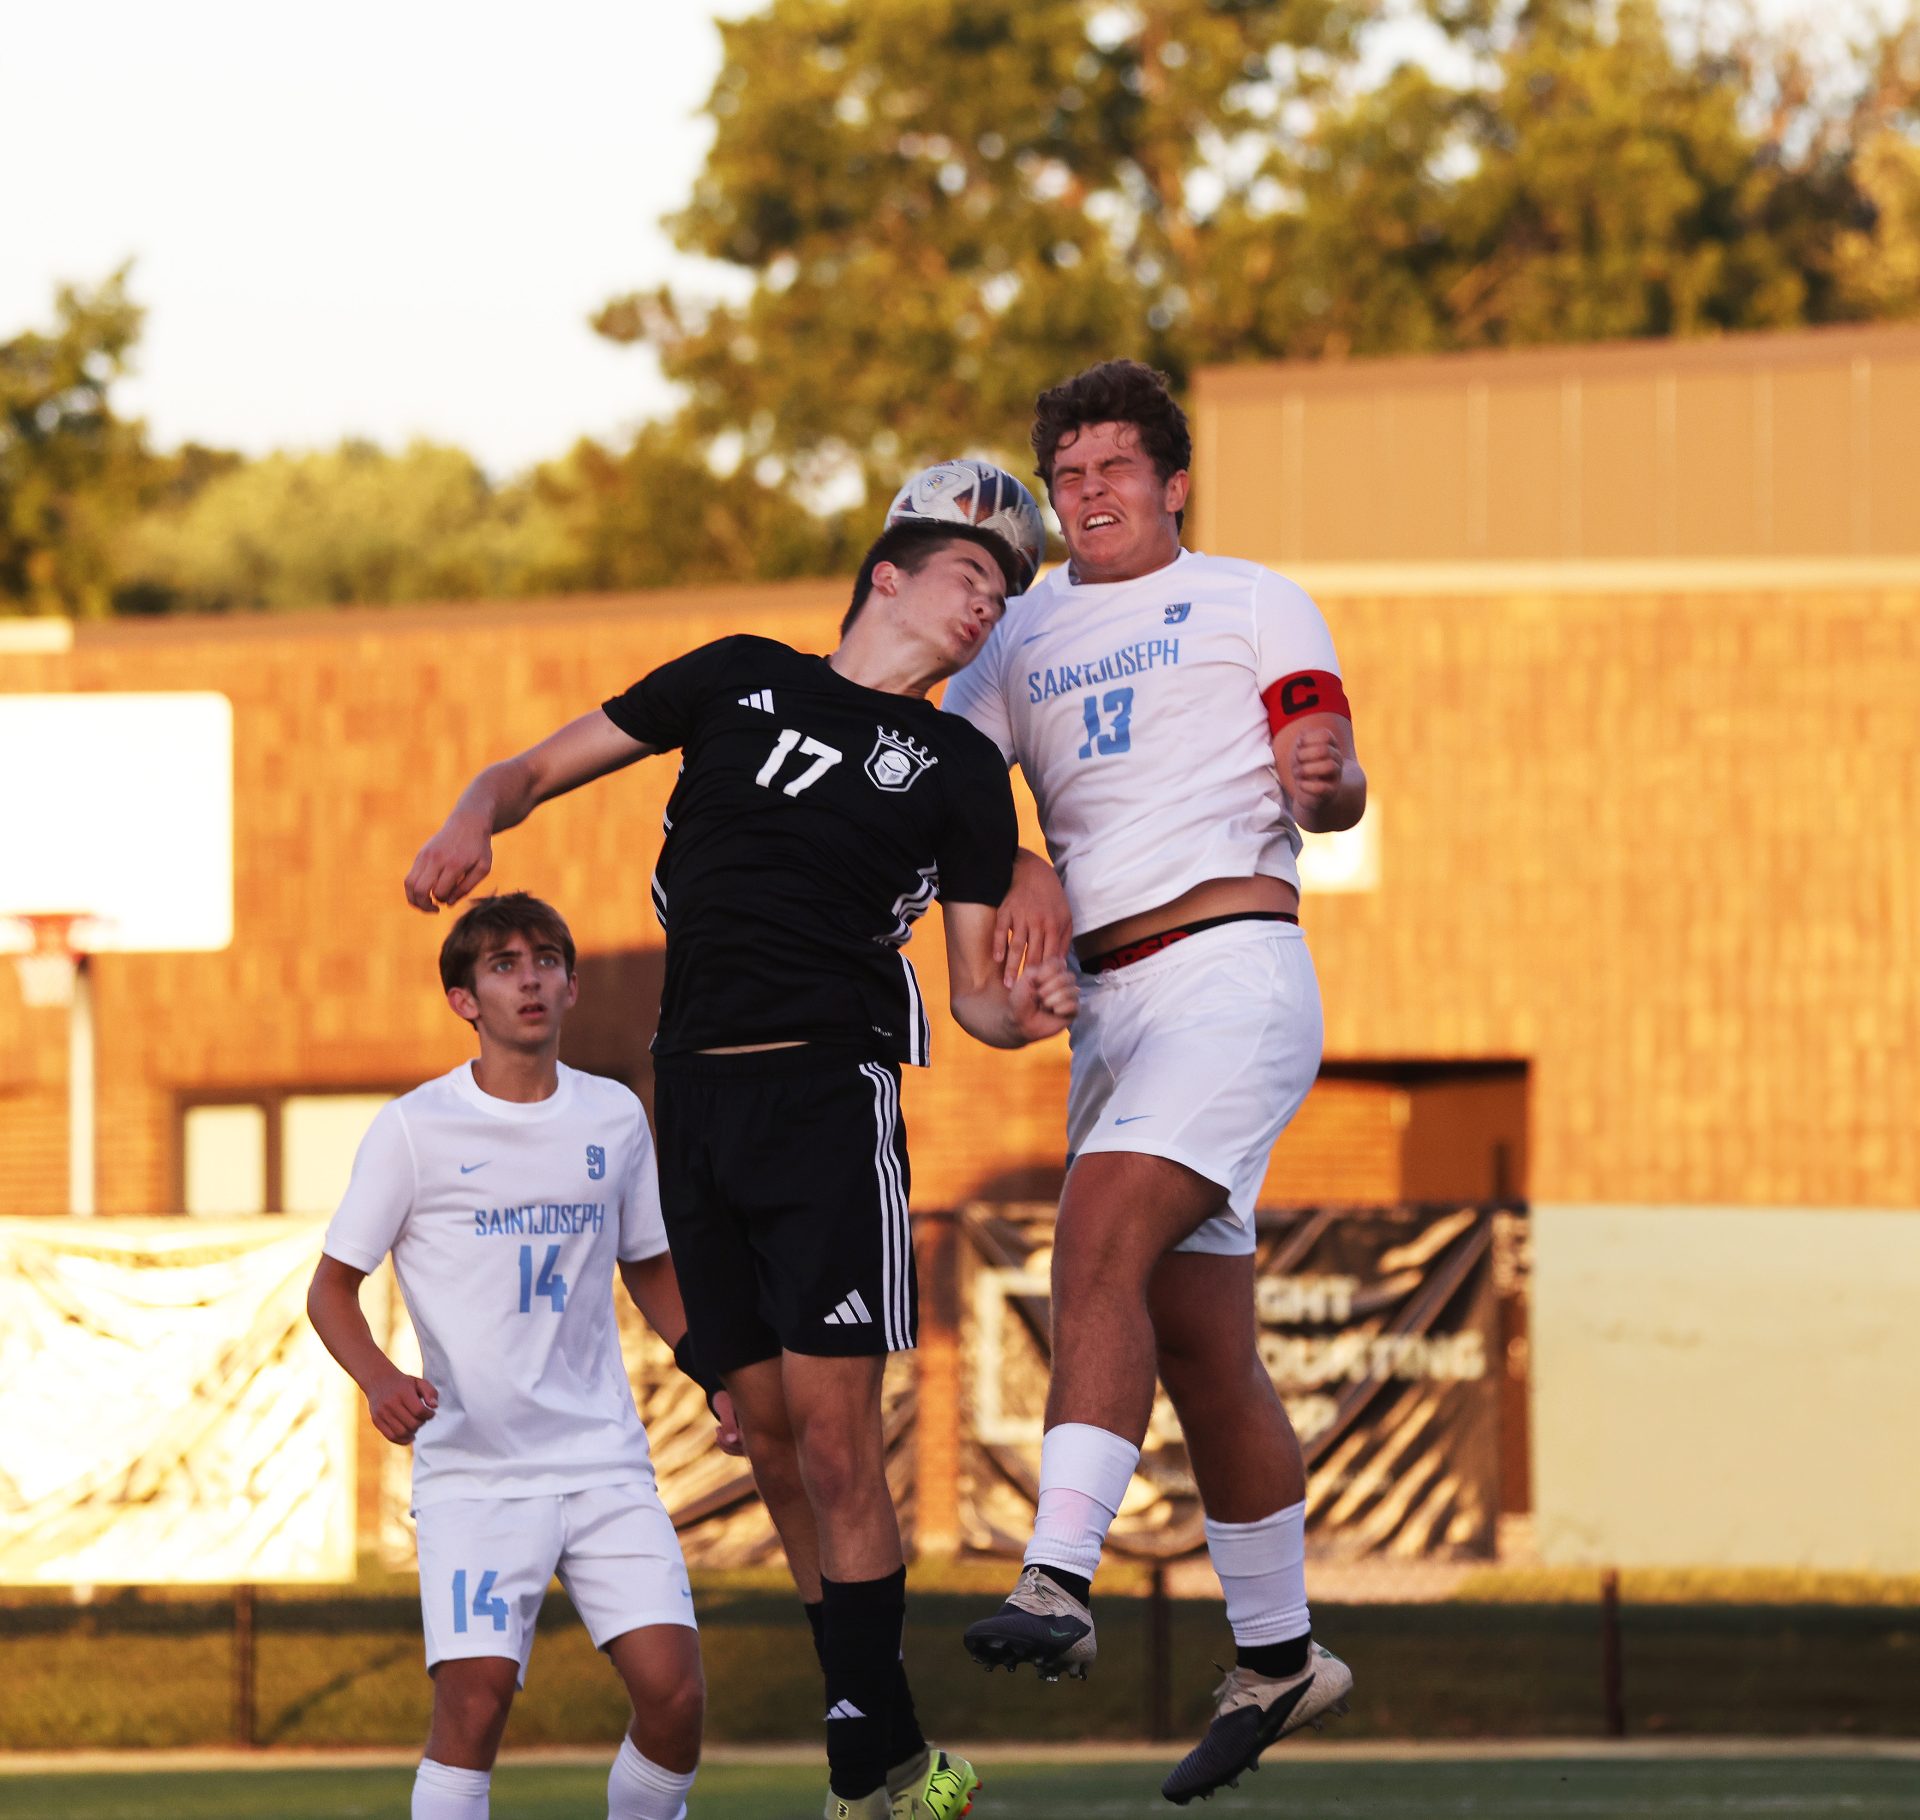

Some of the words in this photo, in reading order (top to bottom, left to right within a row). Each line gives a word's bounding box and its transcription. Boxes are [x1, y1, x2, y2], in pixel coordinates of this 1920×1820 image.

[1078, 687, 1134, 760] 13
[1281, 676, 1319, 716] C
[756, 729, 843, 798] 17
[518, 1244, 568, 1314] 14
[452, 1569, 509, 1634] 14
